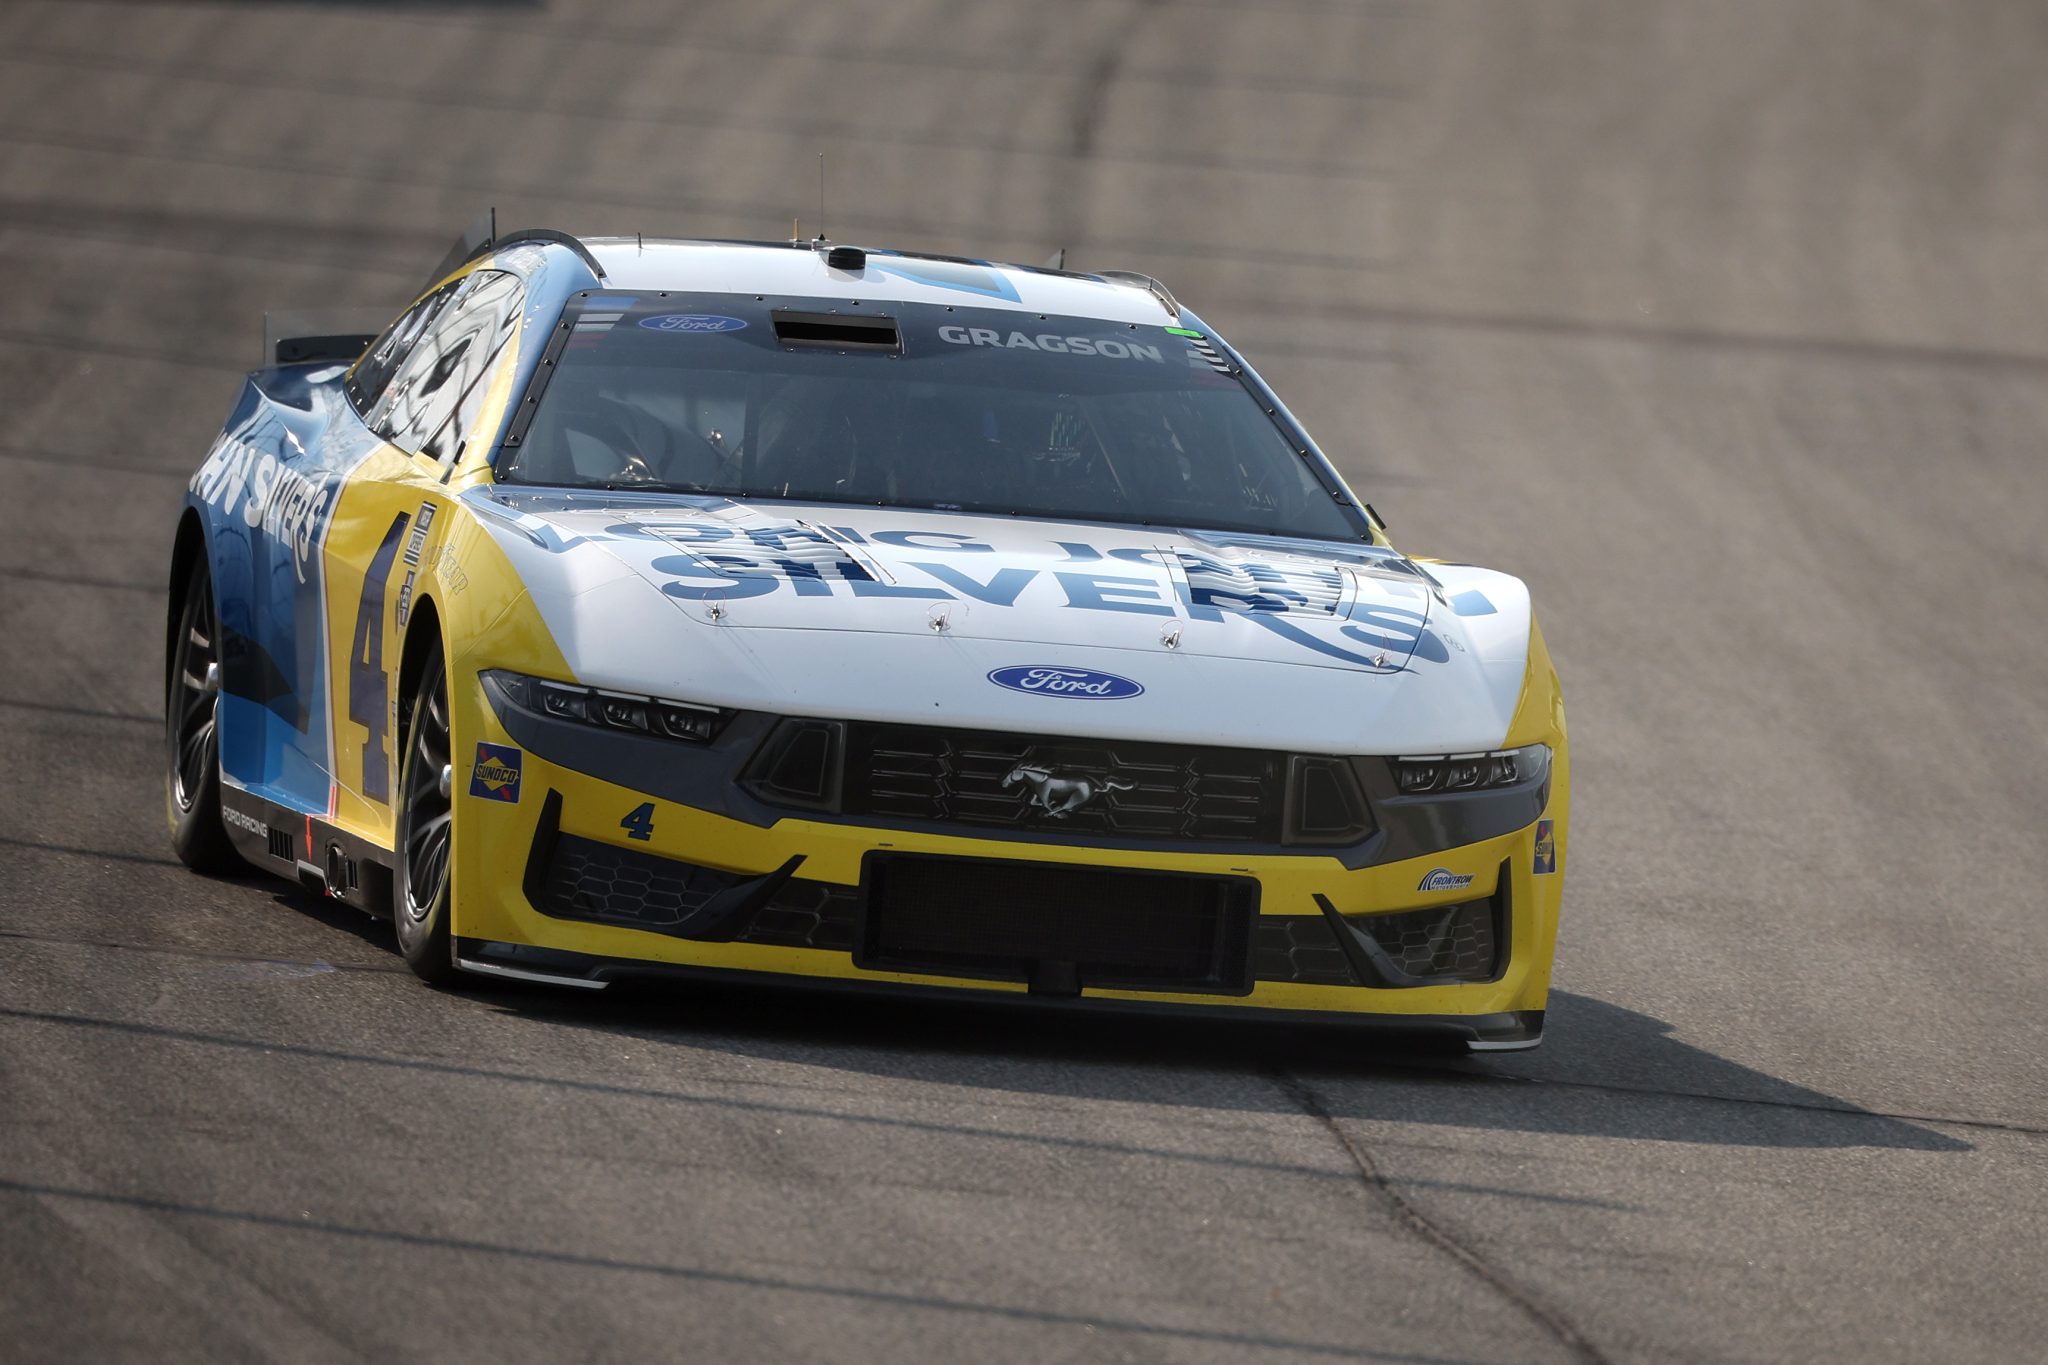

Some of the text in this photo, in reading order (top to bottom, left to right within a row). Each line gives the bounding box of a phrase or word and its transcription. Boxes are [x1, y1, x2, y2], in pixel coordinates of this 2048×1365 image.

[659, 316, 727, 330] Ford
[938, 325, 1166, 364] GRAGSON
[349, 511, 411, 806] 4
[1020, 668, 1113, 695] Ford
[476, 764, 519, 784] SUNOCO
[222, 805, 268, 838] FORD RACING
[620, 801, 656, 842] 4
